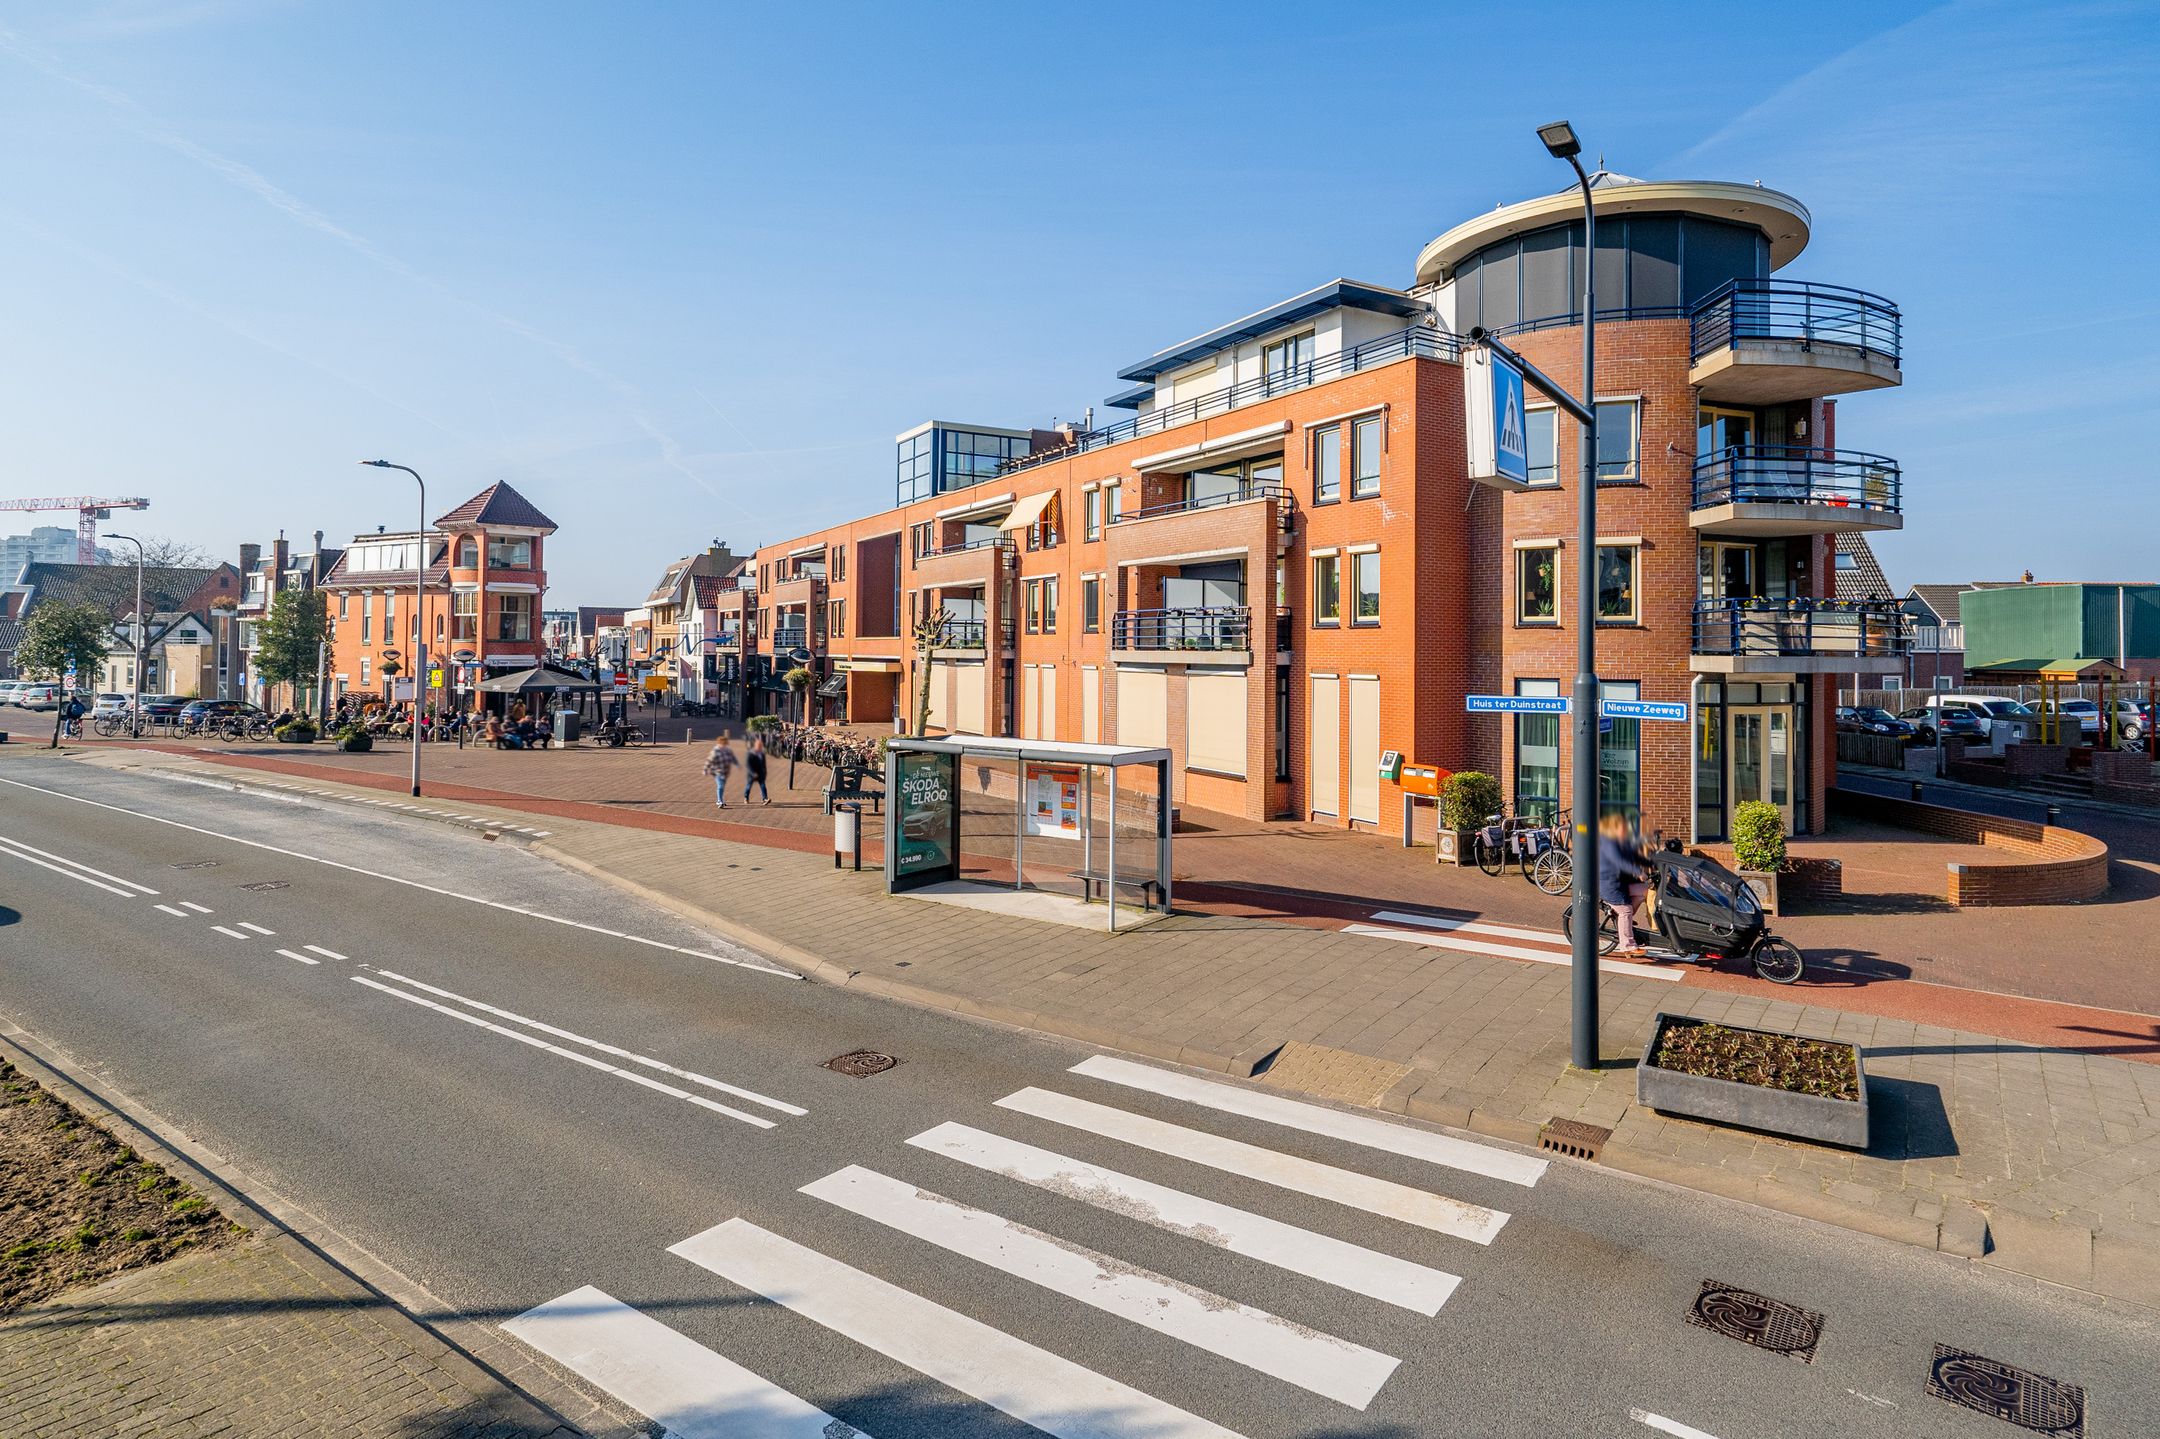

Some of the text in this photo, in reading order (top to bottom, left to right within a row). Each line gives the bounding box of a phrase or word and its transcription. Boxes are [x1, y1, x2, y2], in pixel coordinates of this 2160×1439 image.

[1473, 700, 1561, 710] Huis ter Duinstraat
[1607, 703, 1681, 717] Nieuwe Zeeweg
[920, 769, 940, 778] NIEUWE
[902, 777, 939, 794] ŠKODA
[911, 789, 947, 805] ELROQ
